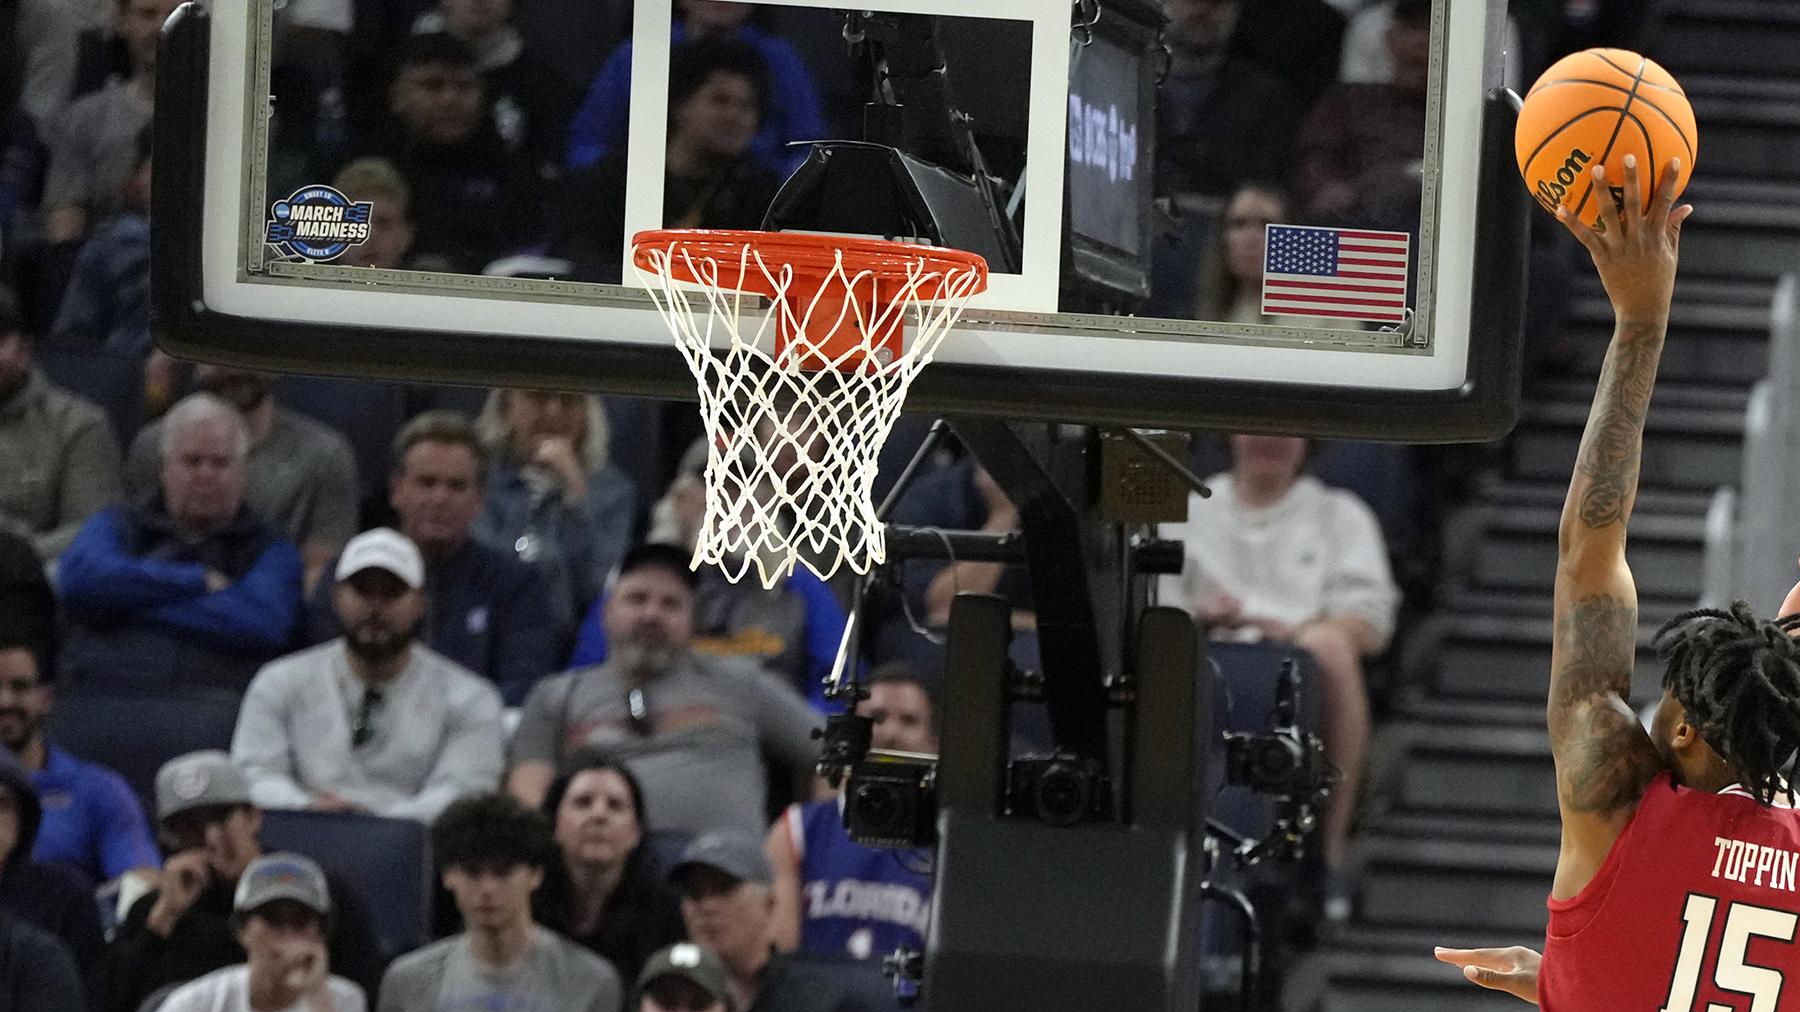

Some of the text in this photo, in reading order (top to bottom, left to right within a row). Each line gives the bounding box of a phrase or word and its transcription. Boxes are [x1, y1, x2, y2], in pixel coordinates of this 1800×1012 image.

[1533, 148, 1592, 214] ilson
[290, 205, 344, 222] MARCH
[296, 221, 369, 239] MADNESS
[1711, 836, 1800, 892] TOPPIN
